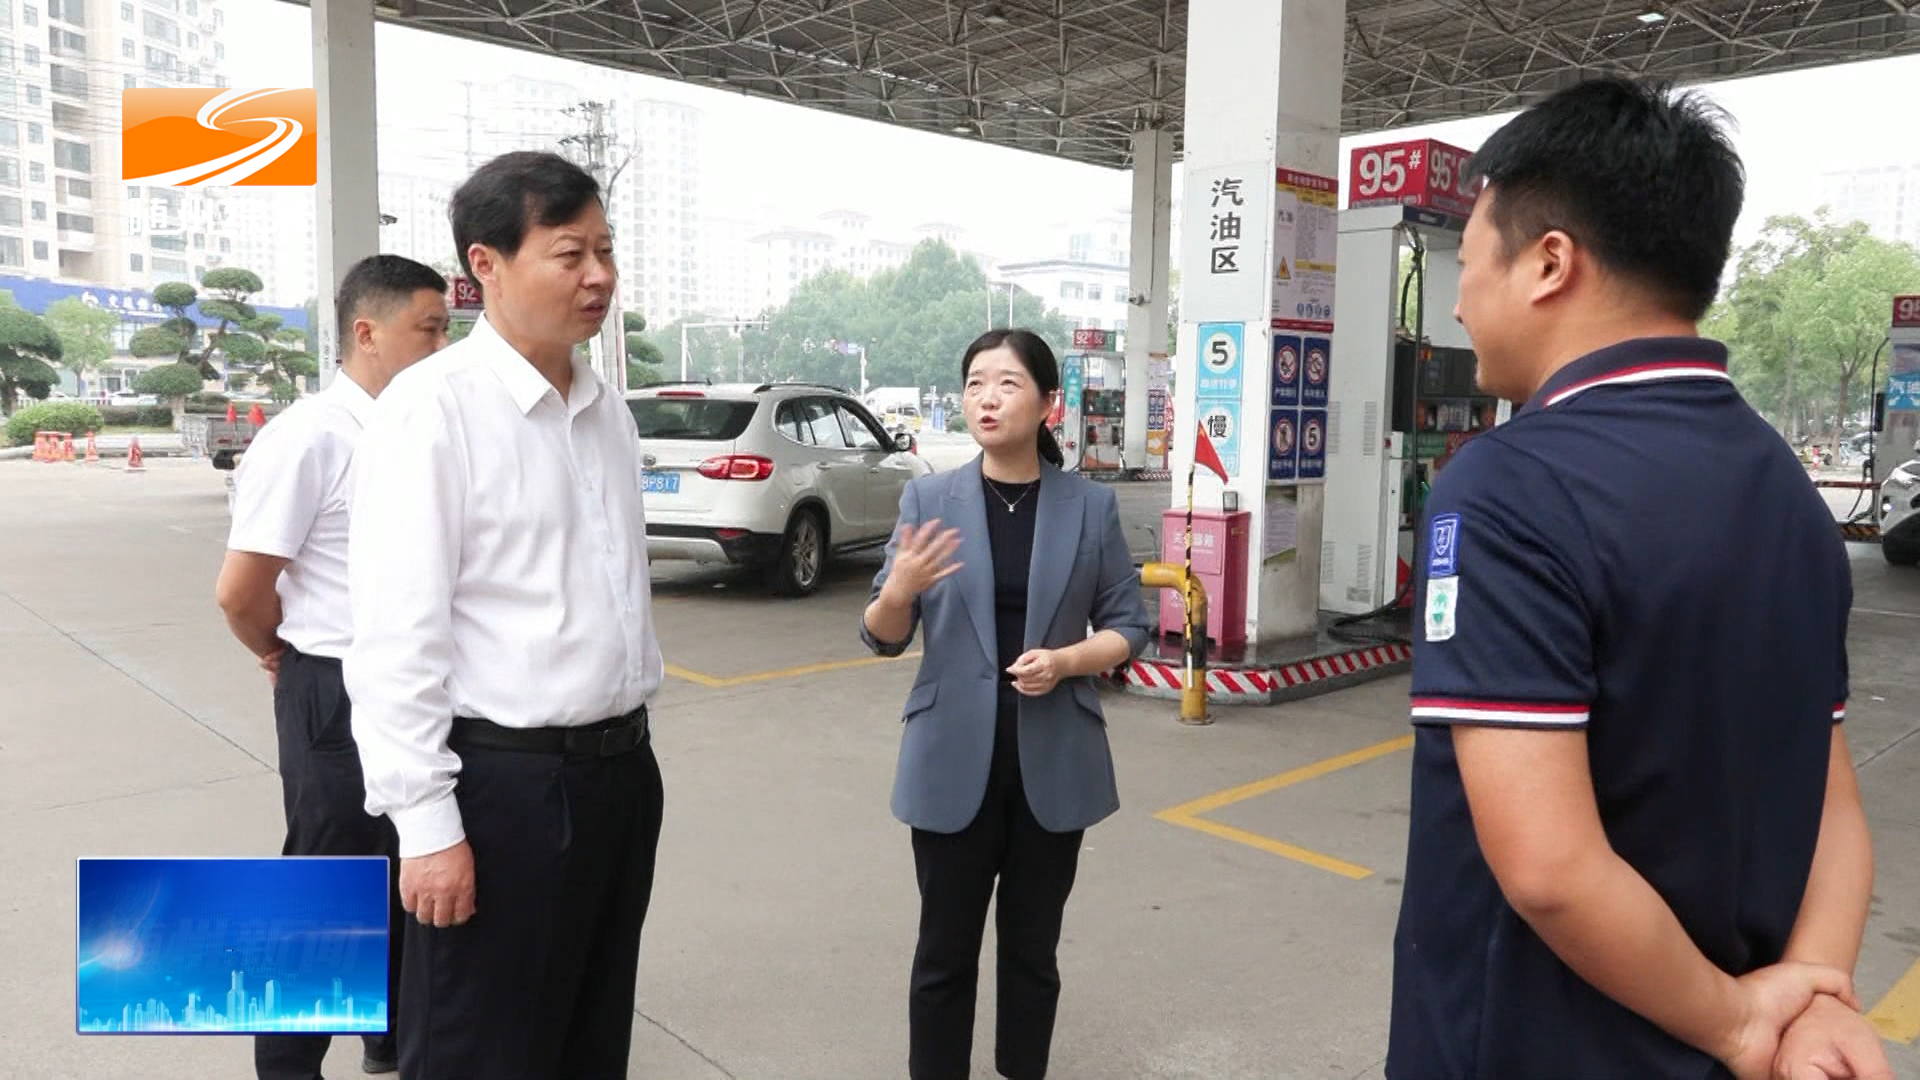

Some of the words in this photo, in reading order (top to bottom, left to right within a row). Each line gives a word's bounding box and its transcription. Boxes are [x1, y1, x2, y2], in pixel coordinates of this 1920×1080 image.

[1358, 148, 1422, 196] 95#
[1209, 177, 1244, 274] 汽油区
[457, 281, 478, 301] 92
[1211, 341, 1229, 366] 5
[1207, 415, 1228, 438] 慢
